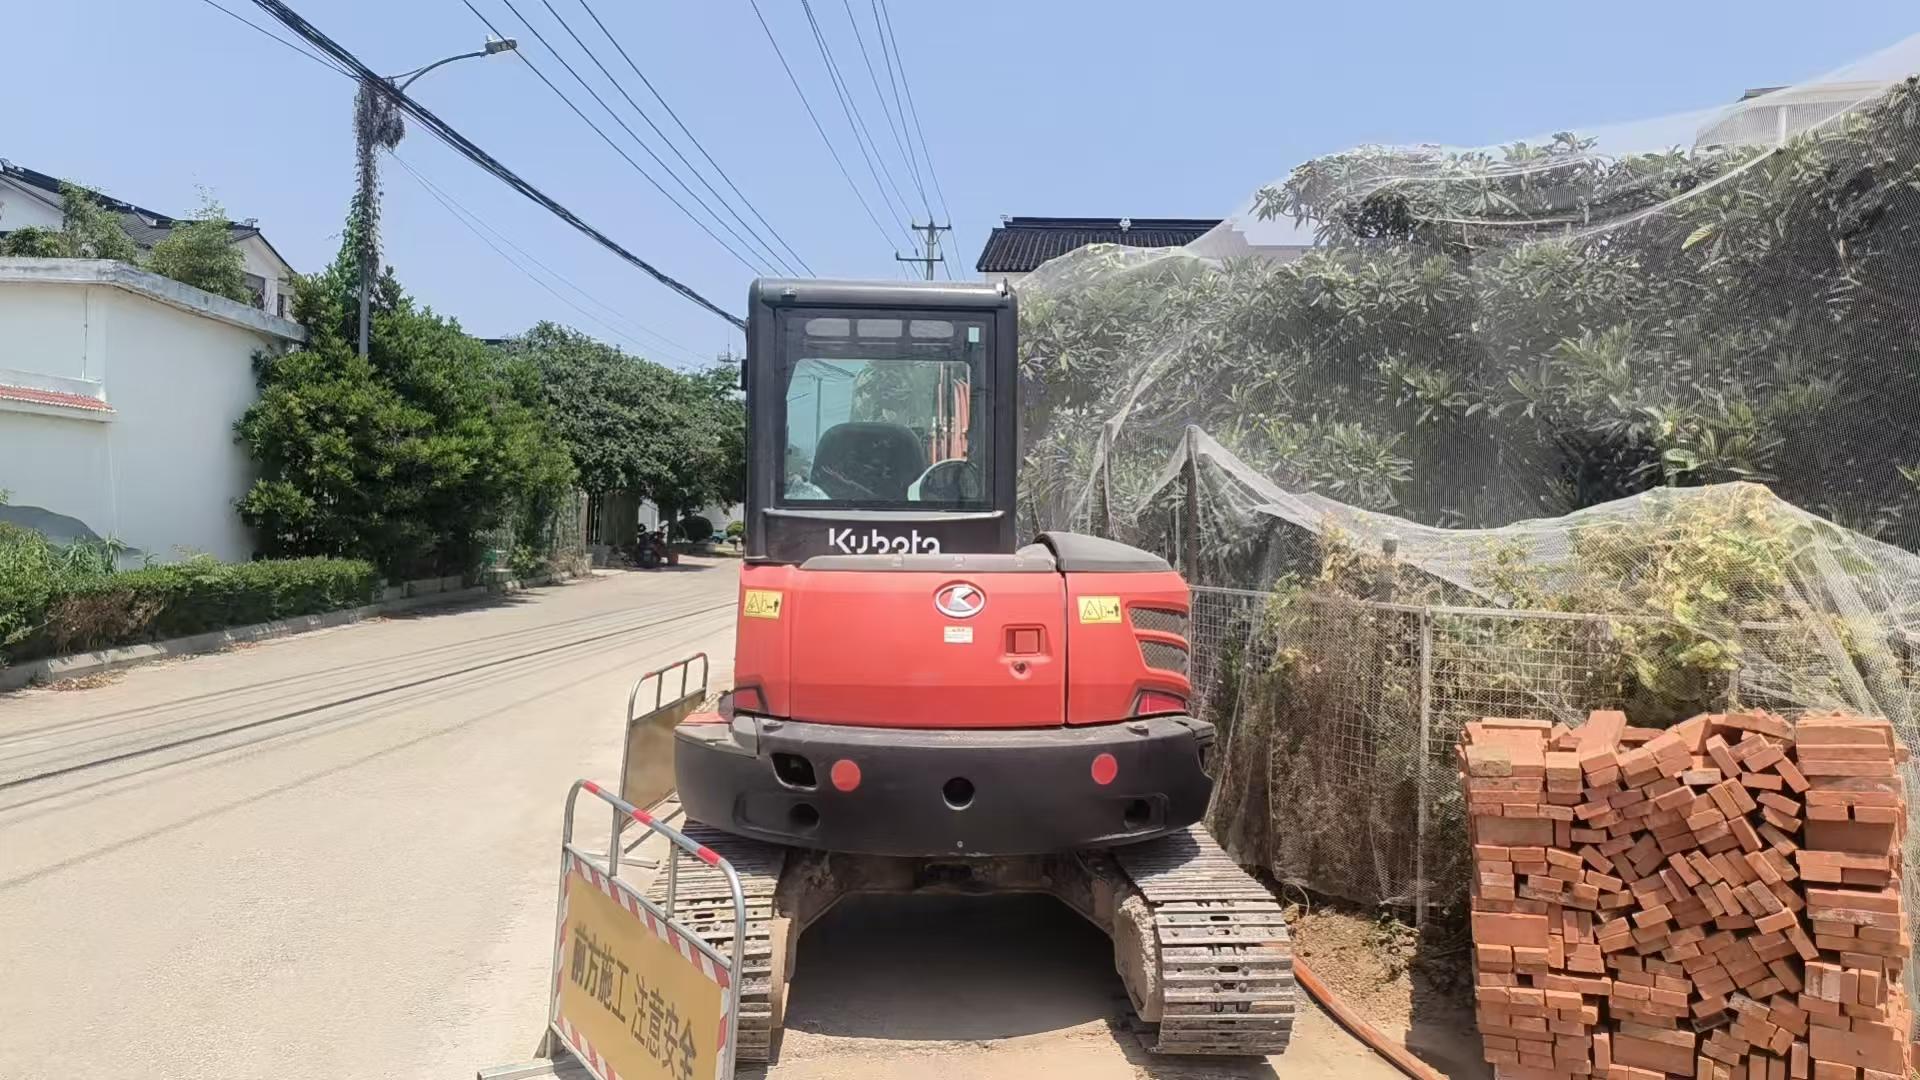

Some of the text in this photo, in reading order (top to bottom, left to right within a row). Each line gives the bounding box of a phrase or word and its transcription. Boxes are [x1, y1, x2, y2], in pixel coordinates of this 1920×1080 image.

[828, 527, 941, 555] Kubota
[571, 920, 697, 1080] 前方施工 注意安全
